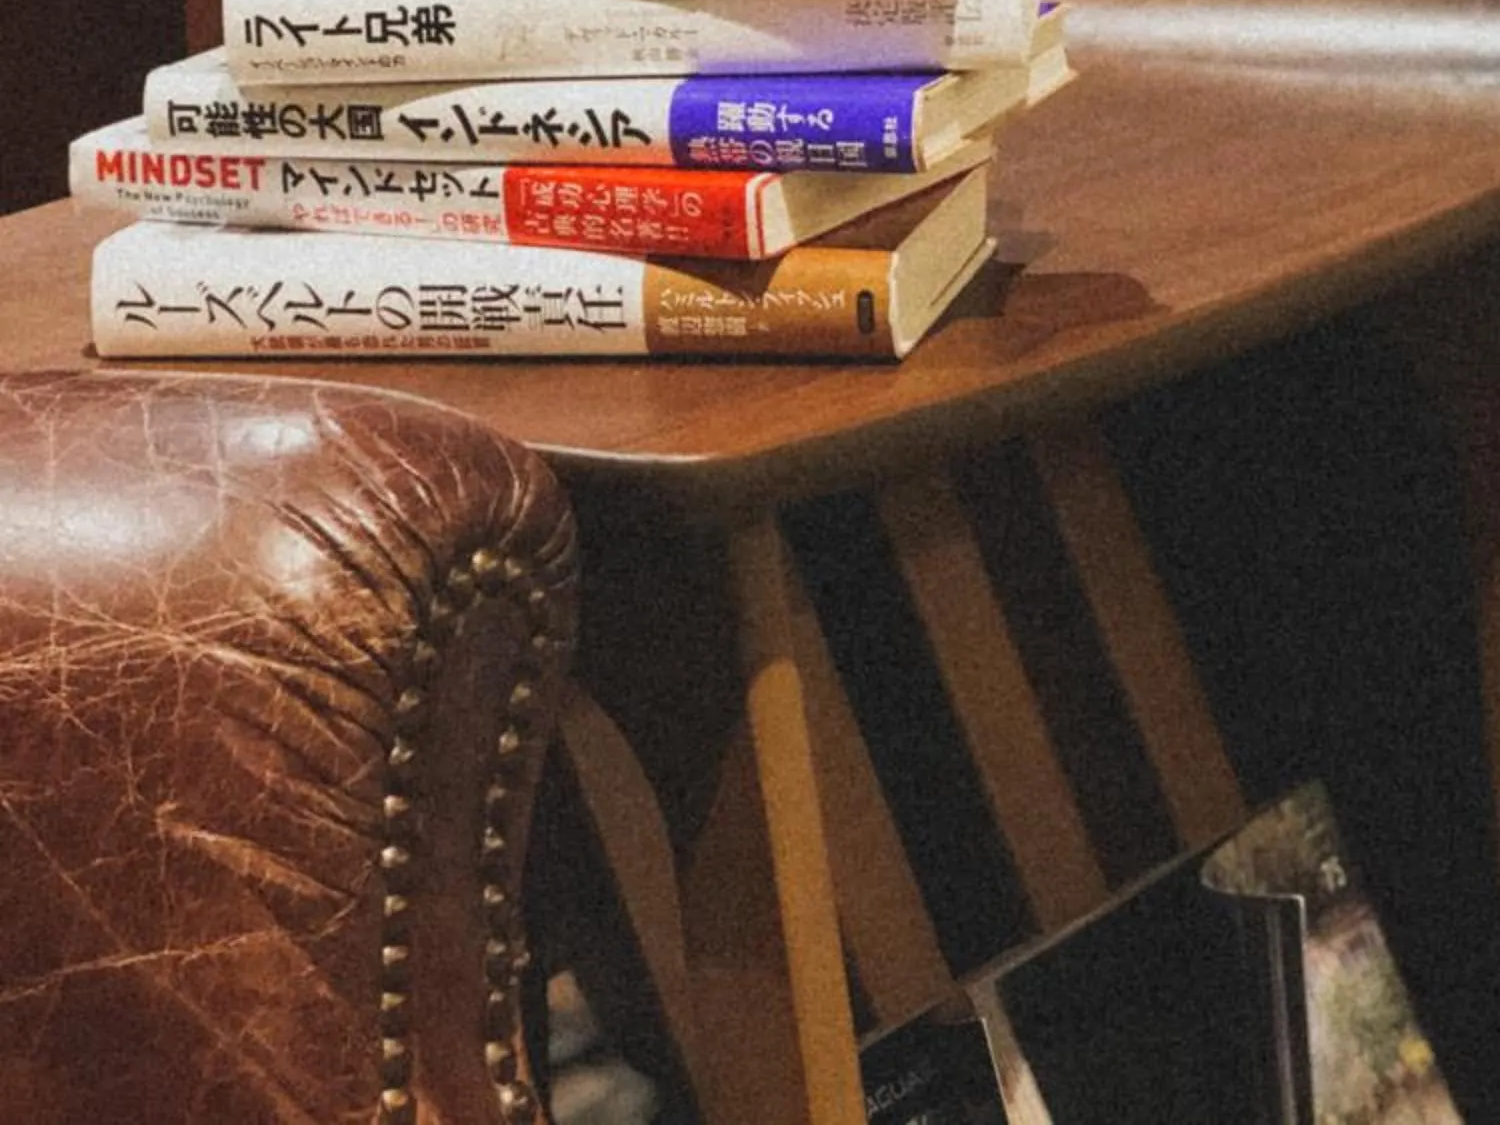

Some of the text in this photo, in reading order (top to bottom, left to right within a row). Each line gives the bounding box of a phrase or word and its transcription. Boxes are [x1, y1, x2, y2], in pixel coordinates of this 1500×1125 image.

[245, 3, 457, 48] ライト兄弟
[167, 100, 652, 149] 可能性の大国 インドネシア
[717, 101, 835, 133] 躍動する
[96, 148, 266, 191] MINDSET
[281, 164, 499, 202] マインドセット
[114, 281, 629, 333] ルーズベルトの開戦責任
